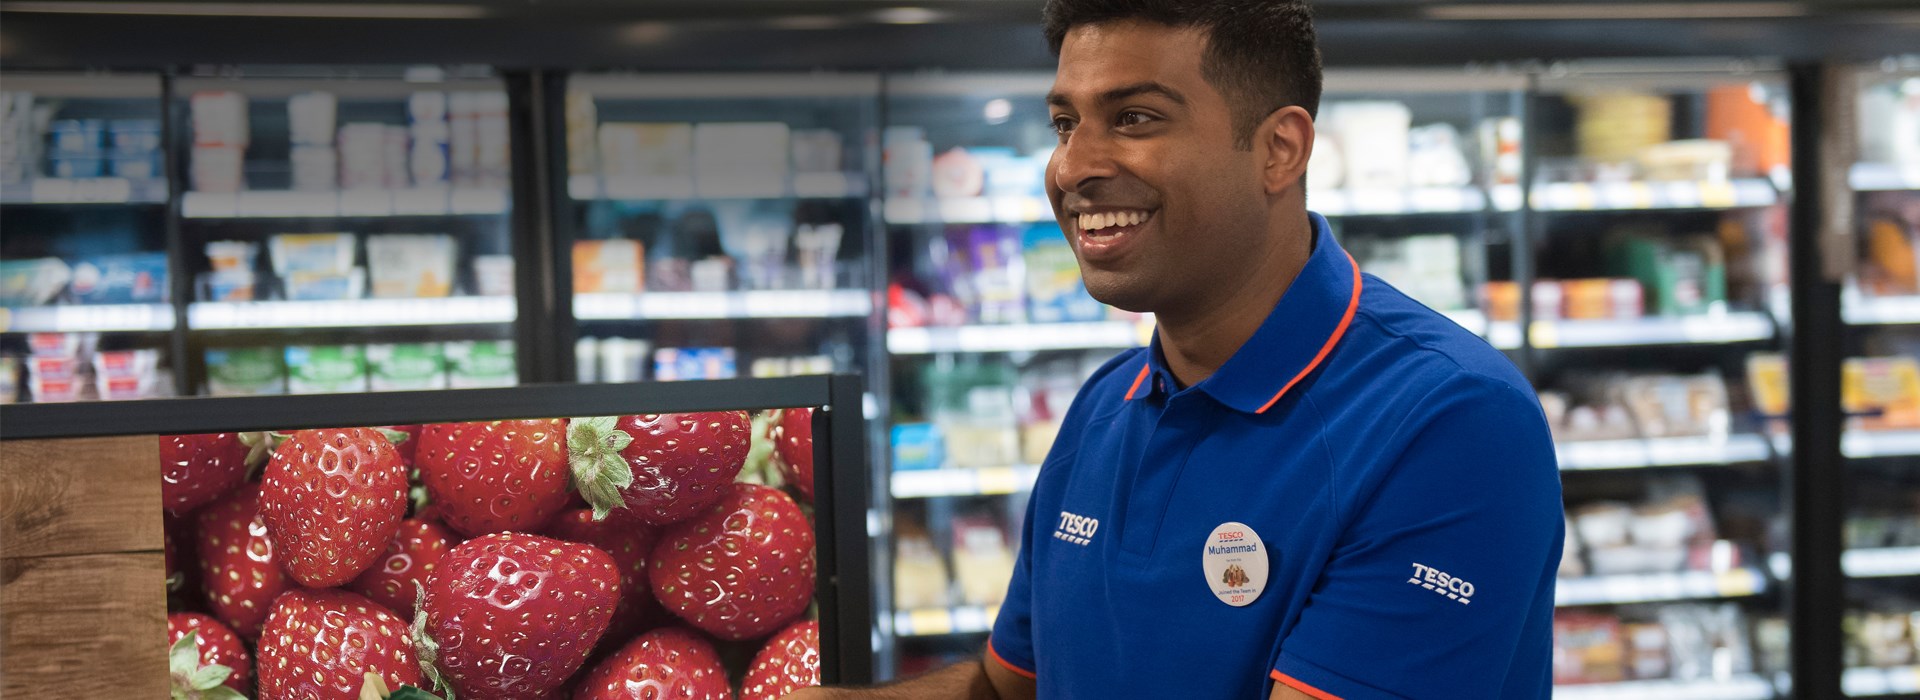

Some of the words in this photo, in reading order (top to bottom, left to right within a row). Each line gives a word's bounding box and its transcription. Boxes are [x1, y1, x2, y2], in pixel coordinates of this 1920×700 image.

[1059, 511, 1099, 538] TESCO
[1218, 531, 1243, 540] TESCO
[1208, 542, 1257, 555] Muhammad
[1412, 562, 1475, 598] TESCO
[1231, 595, 1244, 603] 2017
